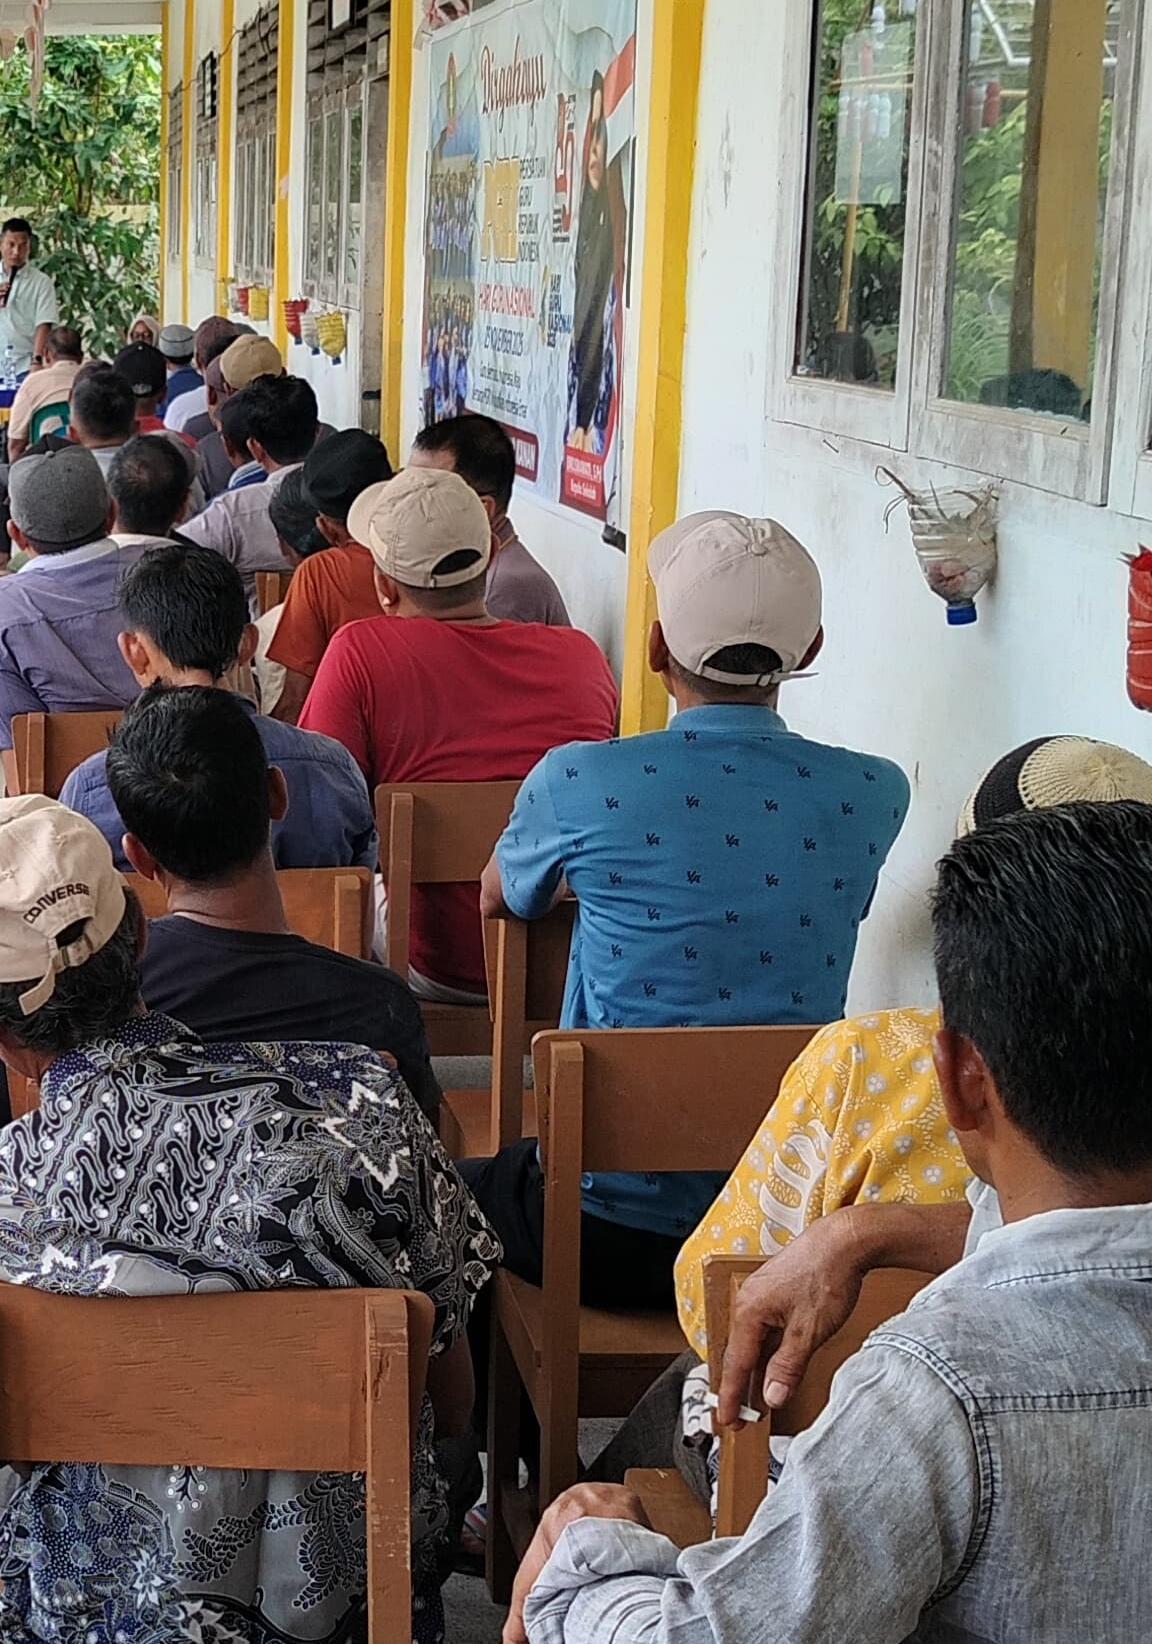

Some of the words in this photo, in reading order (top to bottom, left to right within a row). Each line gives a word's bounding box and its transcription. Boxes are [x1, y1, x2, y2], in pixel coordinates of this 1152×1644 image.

[481, 35, 547, 133] Dirgahayu
[479, 284, 491, 311] HARI
[506, 286, 536, 318] NASIONAL
[548, 312, 573, 335] NASIONAL
[22, 882, 91, 925] CONVERSE
